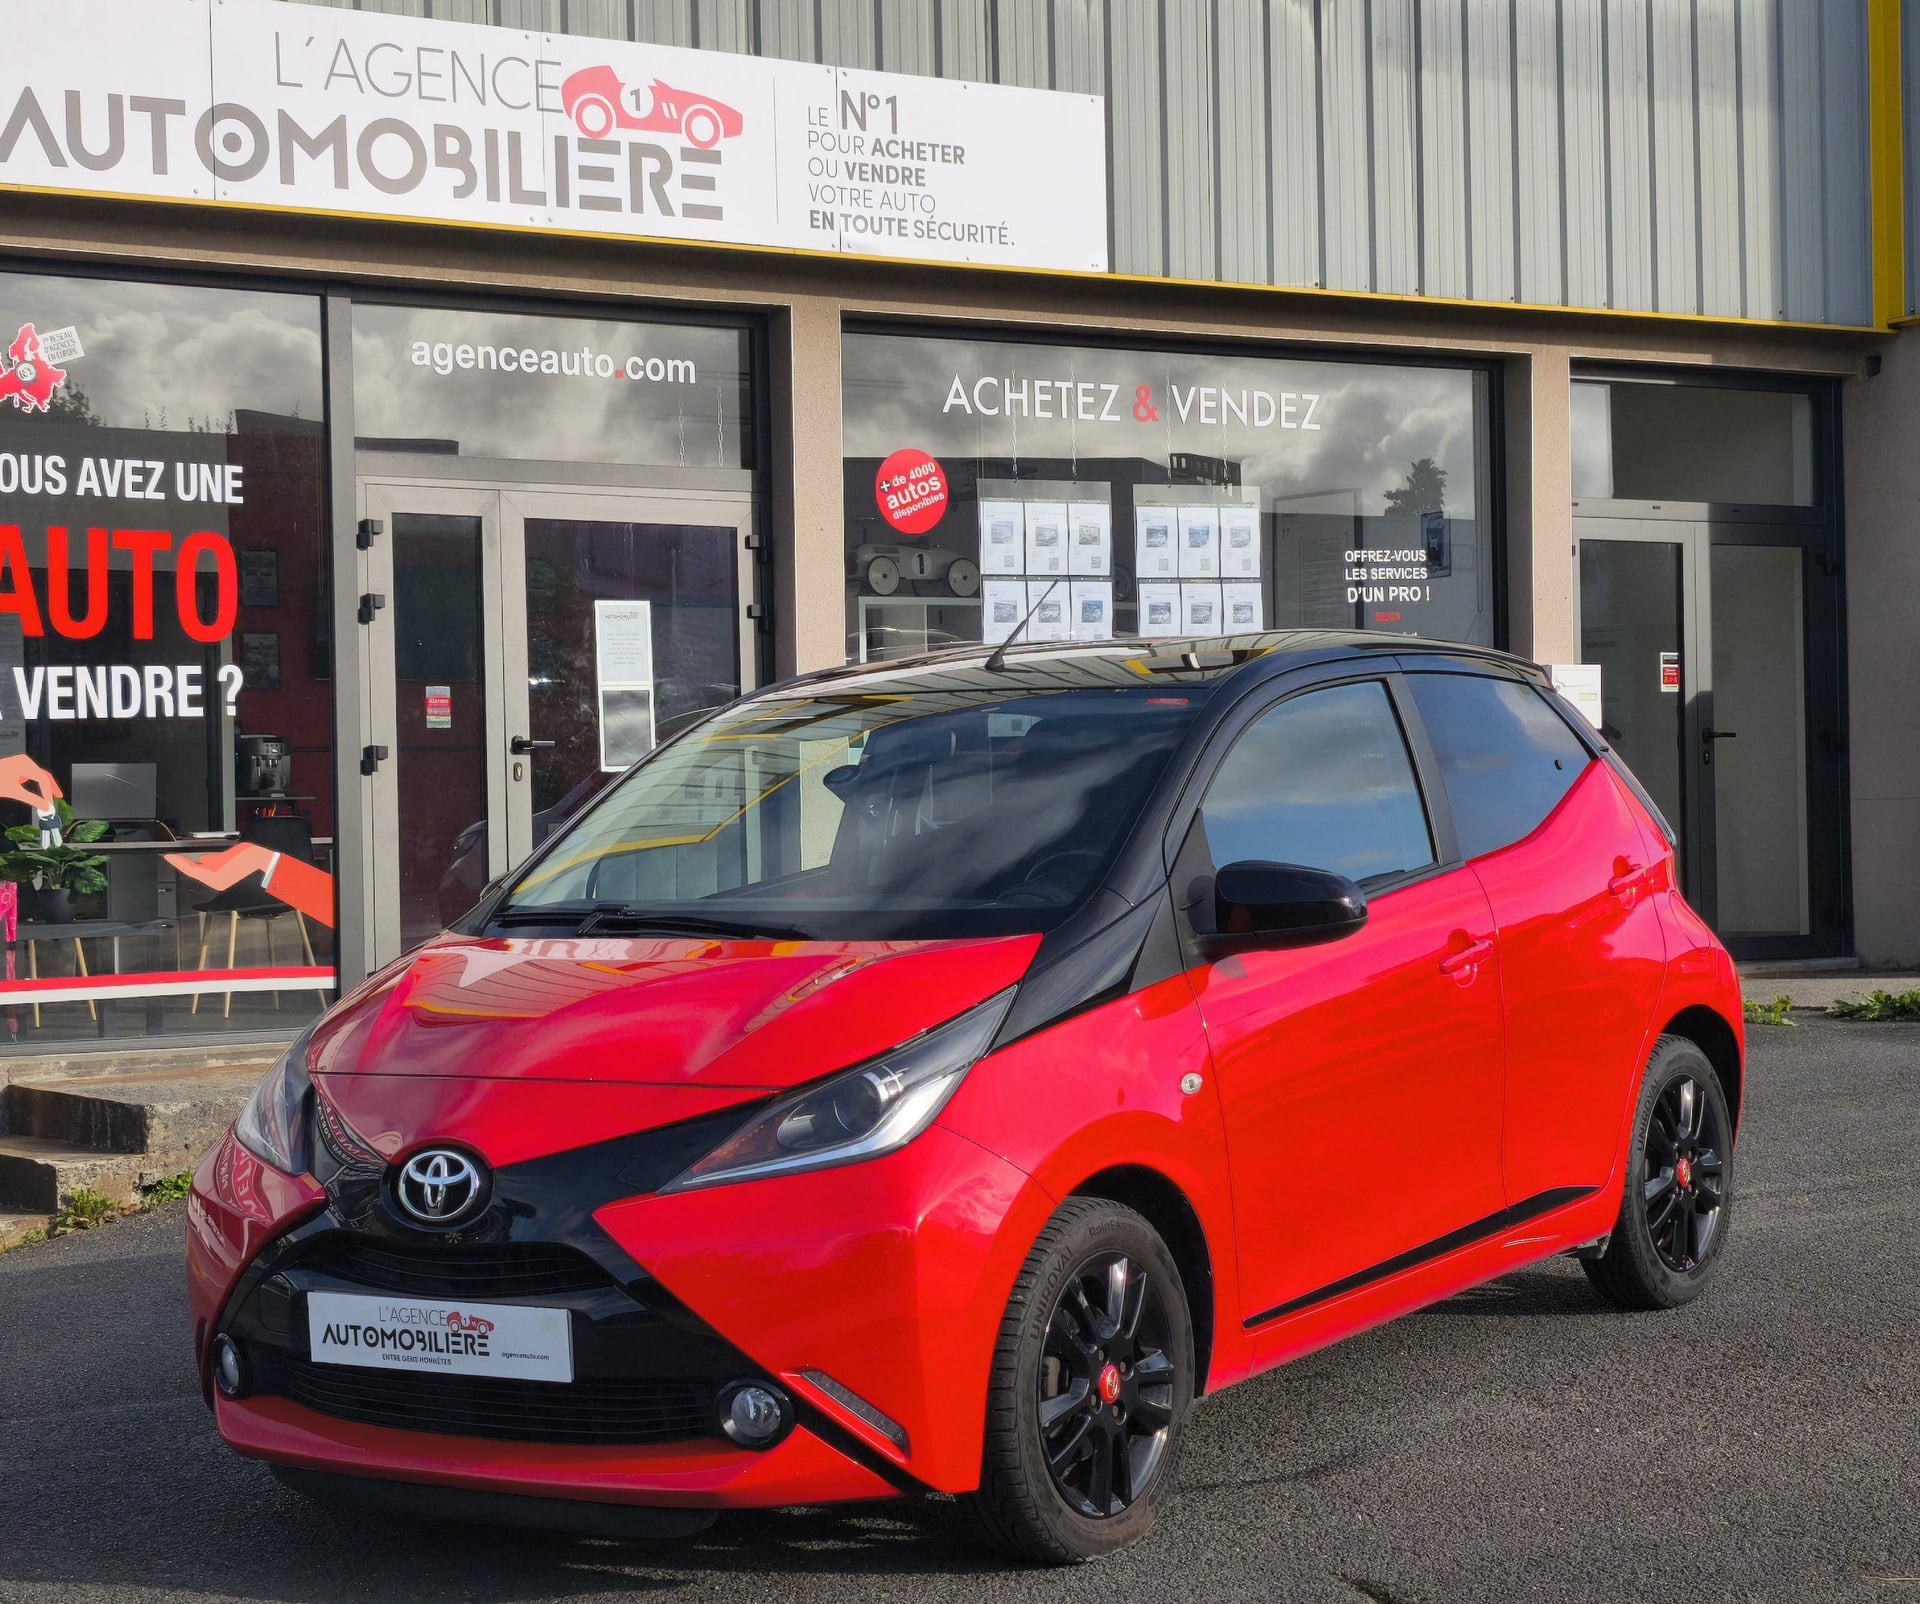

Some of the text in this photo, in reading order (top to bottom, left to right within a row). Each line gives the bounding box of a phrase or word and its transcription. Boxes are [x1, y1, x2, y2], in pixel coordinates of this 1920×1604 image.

[275, 31, 564, 114] L'AGENCE
[808, 106, 829, 128] LE
[0, 86, 723, 221] AUTOMOBILIERE
[808, 131, 966, 165] POUR ACHETER
[808, 157, 926, 187] OU VENDRE
[808, 183, 936, 214] VOTRE AUTO
[809, 210, 1015, 246] EN TOUTE SÉCURITÉ.
[411, 340, 697, 384] agenceauto.com
[942, 374, 1322, 431] ACHETEZ & VENDEZ
[76, 457, 165, 501] AVEZ
[176, 462, 244, 504] UNE
[892, 474, 907, 488] de
[909, 462, 936, 480] 4000
[886, 475, 942, 510] autos
[892, 492, 945, 520] disponibles
[1344, 549, 1427, 562] OFFREZ-VOUS
[1345, 567, 1428, 580] LES SERVICES
[1347, 585, 1430, 603] D'UN PRO !
[13, 664, 245, 720] VENDRE ?
[379, 1306, 447, 1327] L'AGENCE
[322, 1323, 490, 1357] AUTOMOBILIERE
